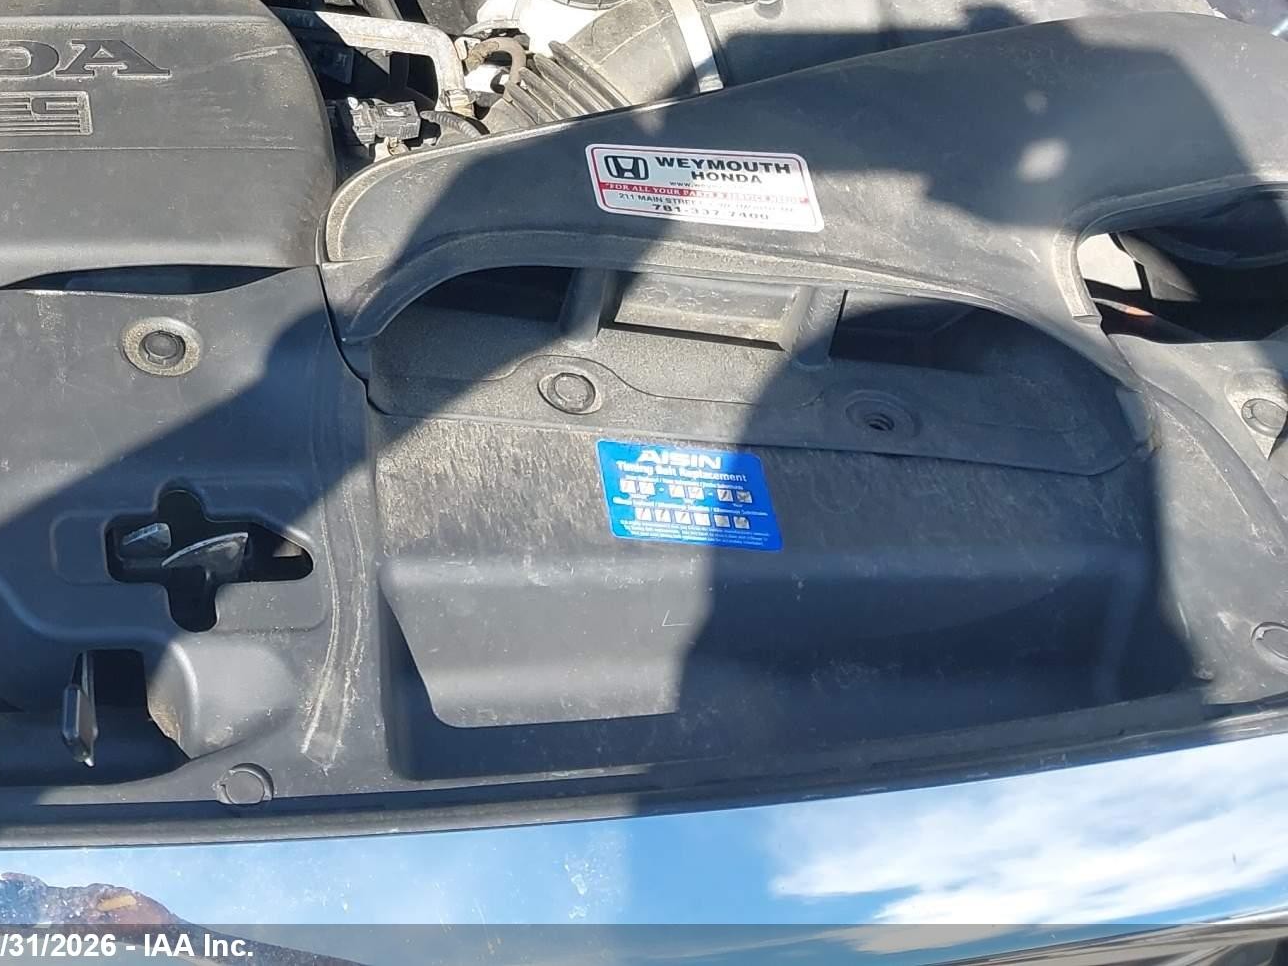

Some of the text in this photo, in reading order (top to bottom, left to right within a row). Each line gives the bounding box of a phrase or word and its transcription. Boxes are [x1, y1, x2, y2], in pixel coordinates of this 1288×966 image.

[655, 156, 791, 174] WEYMOUTH
[691, 171, 762, 184] HONDA
[638, 195, 662, 203] MAIN
[653, 187, 680, 195] YOUR
[652, 204, 769, 220] 781-3377400
[637, 450, 722, 469] AISIN
[616, 461, 748, 482] Timing Belt Replacement
